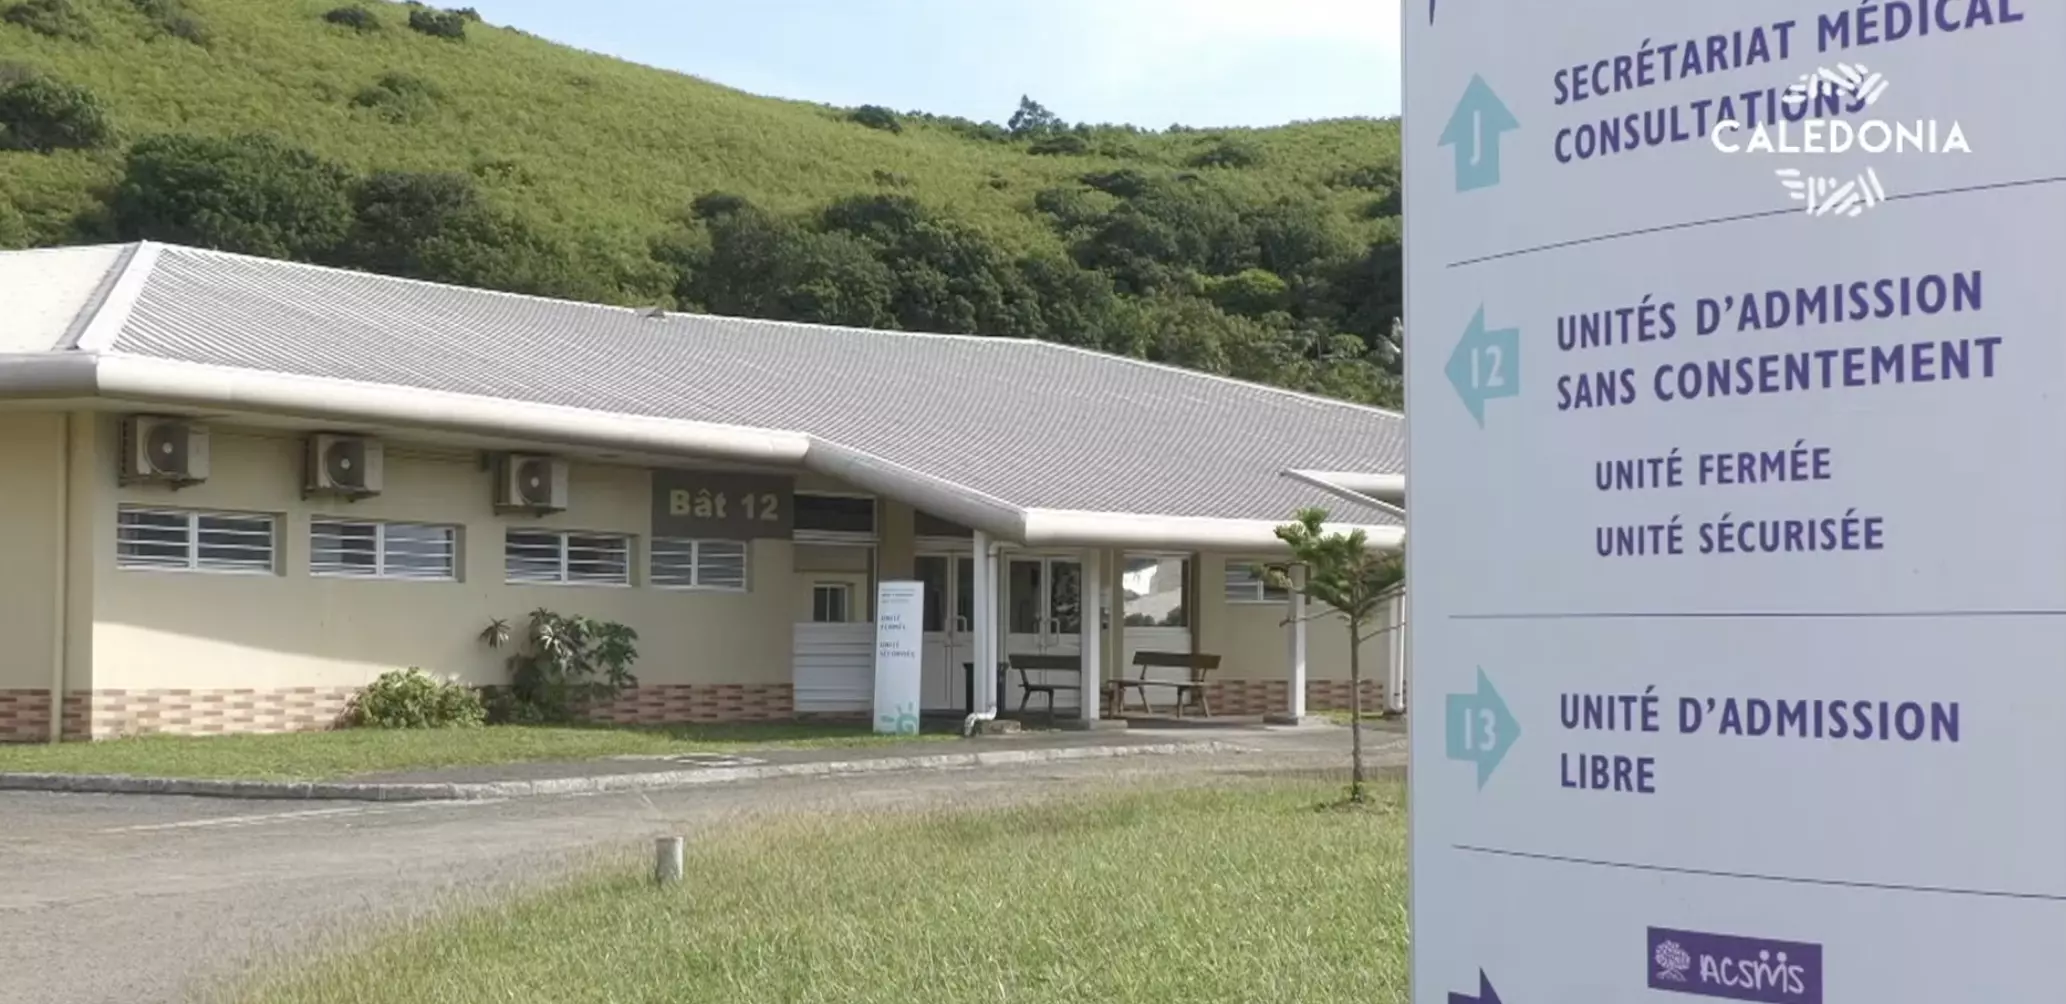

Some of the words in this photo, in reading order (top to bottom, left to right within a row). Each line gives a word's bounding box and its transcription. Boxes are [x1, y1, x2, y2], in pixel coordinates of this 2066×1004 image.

[1554, 20, 1796, 105] SECRÉTARIAT
[1469, 110, 1482, 166] J
[1557, 295, 1677, 351] UNITÉS
[1470, 345, 1505, 390] 12
[1557, 368, 1637, 411] SANS
[1653, 336, 2003, 402] CONSENTEMENT
[1596, 447, 1683, 490] UNITÉ
[1699, 439, 1831, 486] FERMÉE
[669, 488, 727, 519] Bât
[741, 493, 779, 521] 12
[1596, 515, 1684, 557] UNITÉ
[1699, 508, 1884, 554] SÉCURISÉE
[1463, 708, 1497, 752] 13
[1560, 685, 1660, 732] UNITÉ
[1561, 752, 1656, 794] LIBRE
